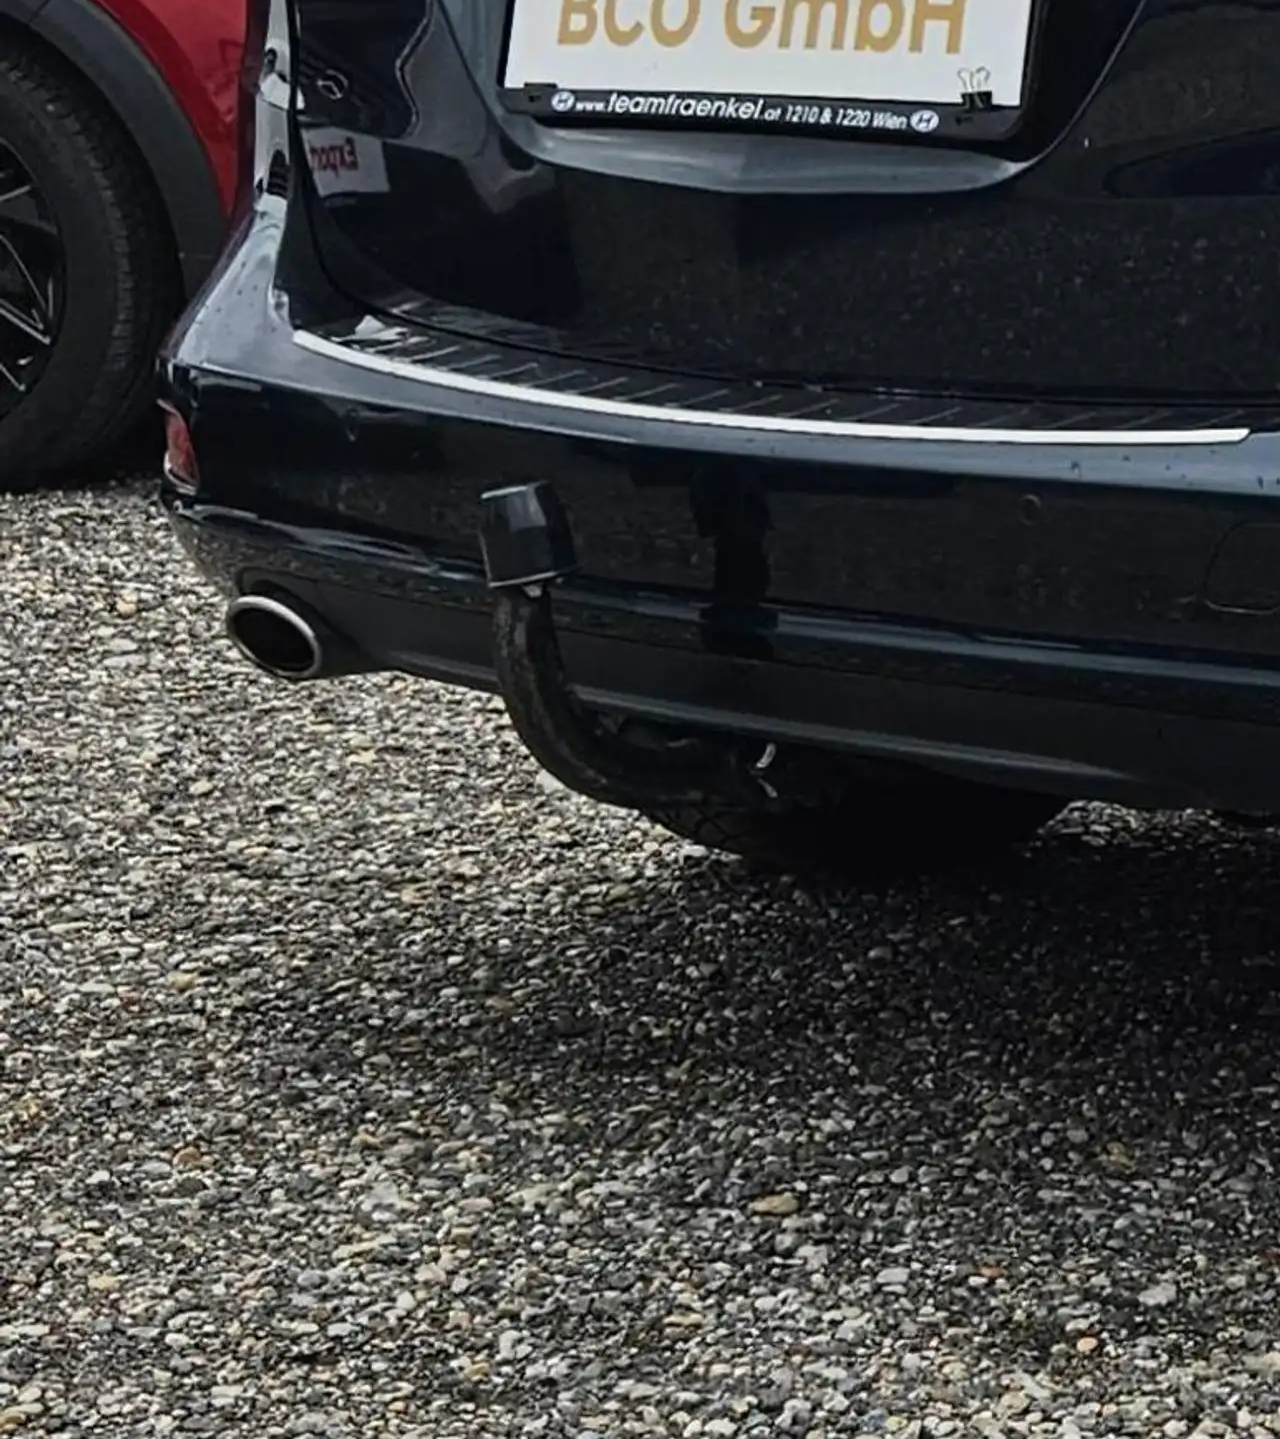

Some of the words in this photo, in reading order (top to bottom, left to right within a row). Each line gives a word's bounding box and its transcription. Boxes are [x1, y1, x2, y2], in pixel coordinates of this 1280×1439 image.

[575, 91, 781, 122] www.teamfraenkel.at
[785, 104, 819, 124] 1210
[820, 106, 833, 125] &
[835, 107, 870, 127] 1220
[871, 110, 908, 130] Wien
